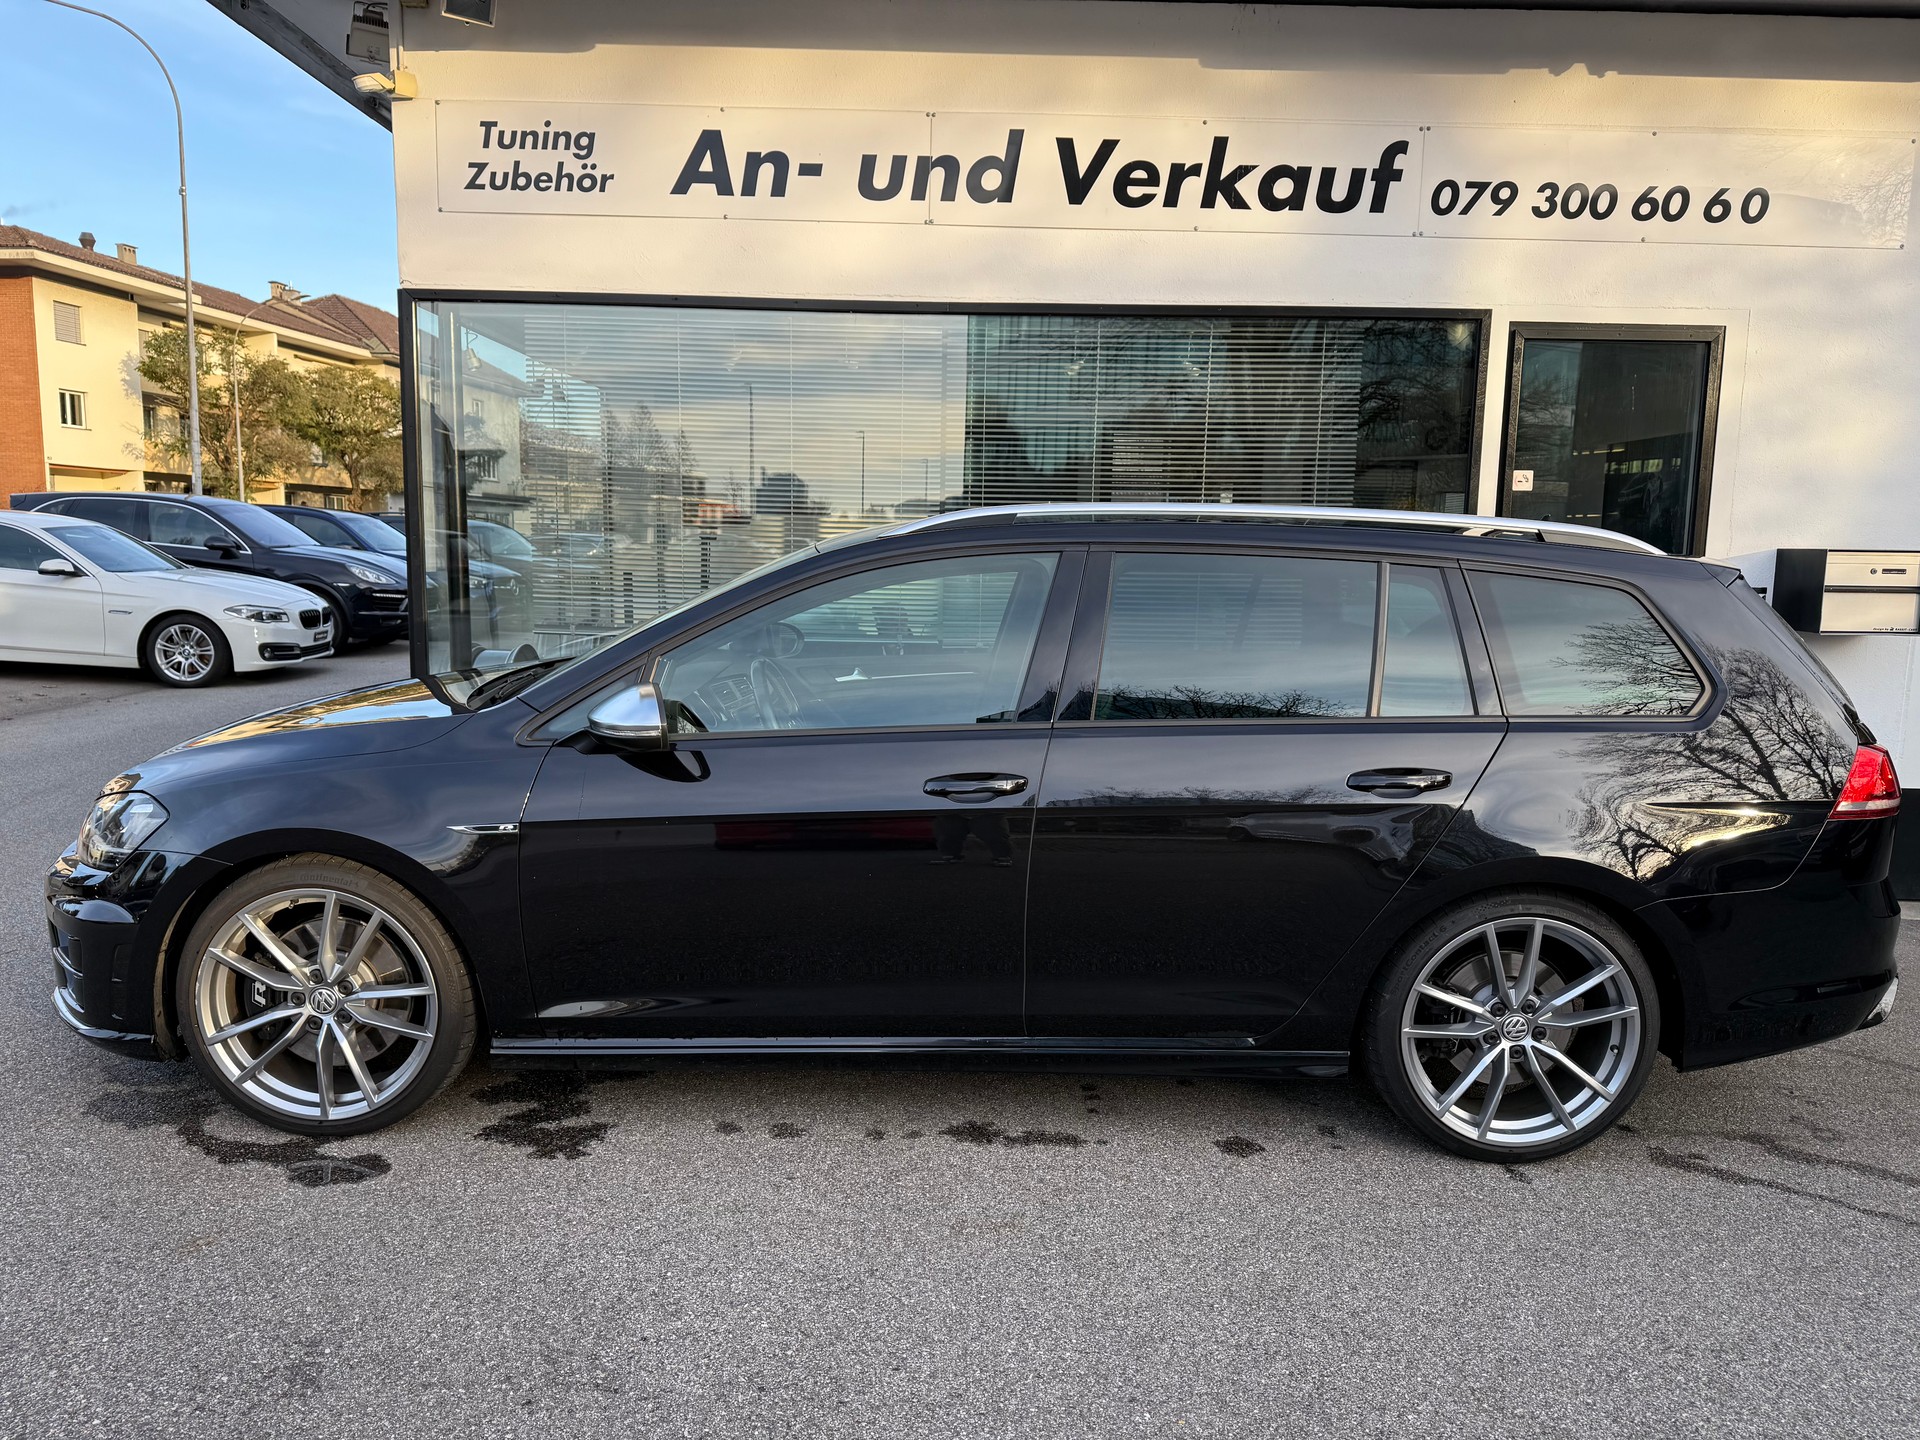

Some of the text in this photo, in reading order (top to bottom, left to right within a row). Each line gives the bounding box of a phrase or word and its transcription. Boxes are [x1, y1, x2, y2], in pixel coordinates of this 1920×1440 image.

[480, 120, 596, 160] Tuning
[463, 160, 615, 193] Zubehör
[669, 128, 1410, 215] An- und Verkauf
[1430, 178, 1519, 217] 079
[1531, 181, 1619, 221] 300
[1631, 185, 1691, 223] 60
